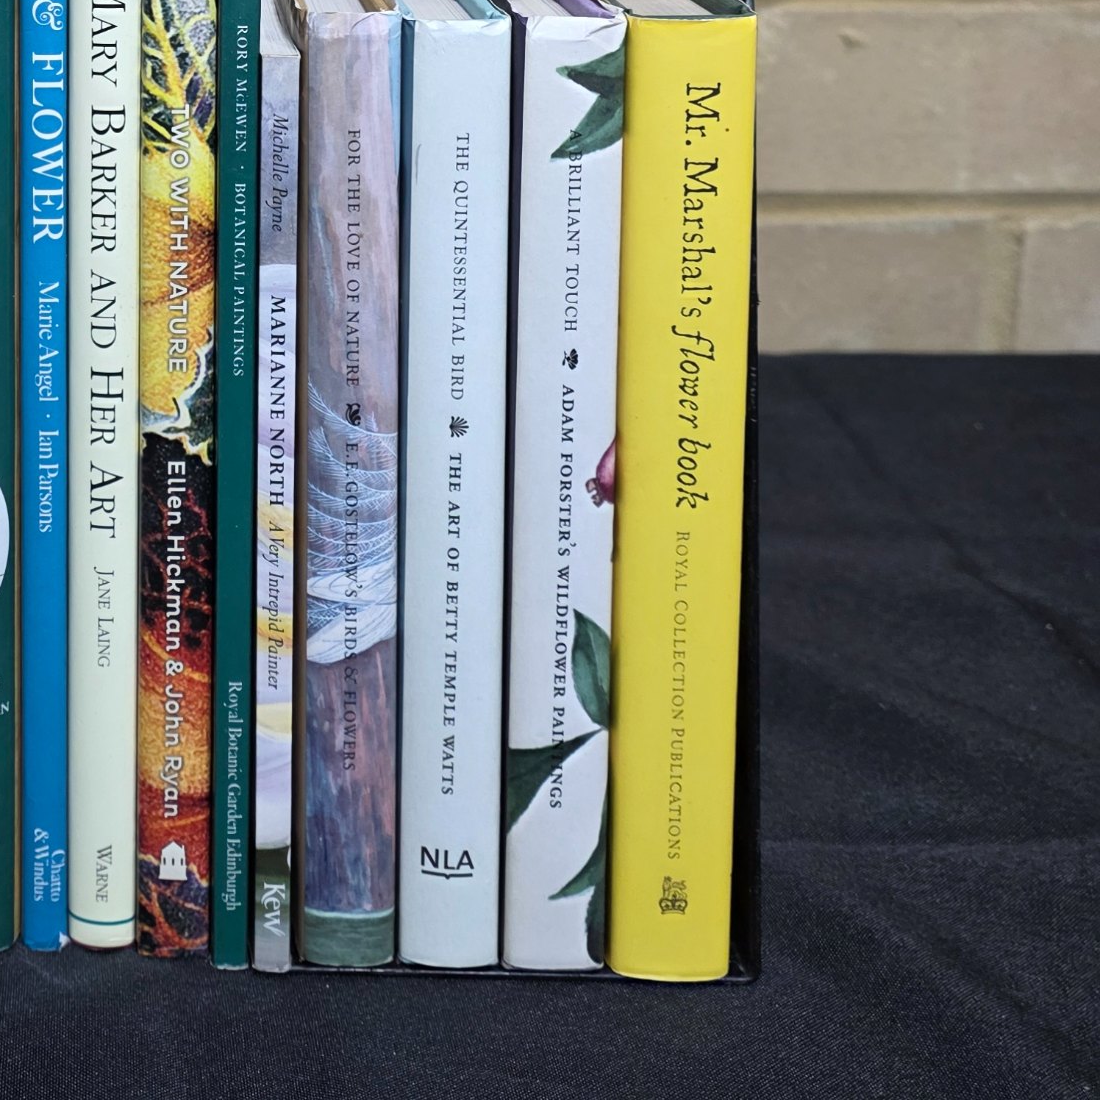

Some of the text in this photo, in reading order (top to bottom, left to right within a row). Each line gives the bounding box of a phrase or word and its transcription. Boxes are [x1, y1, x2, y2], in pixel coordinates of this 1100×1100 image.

[236, 25, 248, 73] RORY
[32, 51, 65, 244] FLOWER
[90, 104, 125, 253] BARKER
[266, 113, 289, 232] Michelle Payne
[167, 104, 189, 373] TWO WITH NATURE
[234, 183, 246, 281] BOTANICAL
[346, 129, 361, 387] FOR THE LOVE OF NATURE
[451, 133, 469, 400] THE QUINTESSENTIAL BIRD
[564, 130, 582, 331] A BRILLIANT TOUCH
[681, 157, 719, 318] Marshal's
[90, 270, 117, 349] AND
[233, 287, 246, 377] PAINTINGS
[34, 281, 60, 532] Marie Angel Ian Parsons
[89, 366, 125, 446] HER
[270, 295, 285, 507] MARIANNE NORTH
[671, 325, 716, 430] flower
[89, 460, 124, 538] ART
[675, 438, 712, 509] book
[93, 566, 115, 668] JANE LAING
[160, 461, 186, 818] Ellen Hickman & John Ryan
[262, 521, 285, 690] A Very Intrepid Painter
[344, 606, 358, 659] BIRDS
[441, 453, 462, 795] THE ART OF BETTY TEMPLE WATTS
[549, 385, 576, 809] ADAM FORSTER'S WILDFLOWER PAINTINGS
[344, 665, 358, 684] &
[667, 531, 690, 860] ROYAL COLLECTION PUBLICATIONS
[343, 691, 357, 771] FLOWERS
[222, 681, 243, 911] Royal Botanic Garden Edinburgh
[34, 827, 50, 901] & Windus
[51, 849, 65, 902] Chatto
[95, 845, 112, 903] WARNE
[264, 882, 286, 937] Kew
[421, 846, 474, 870] NLA
